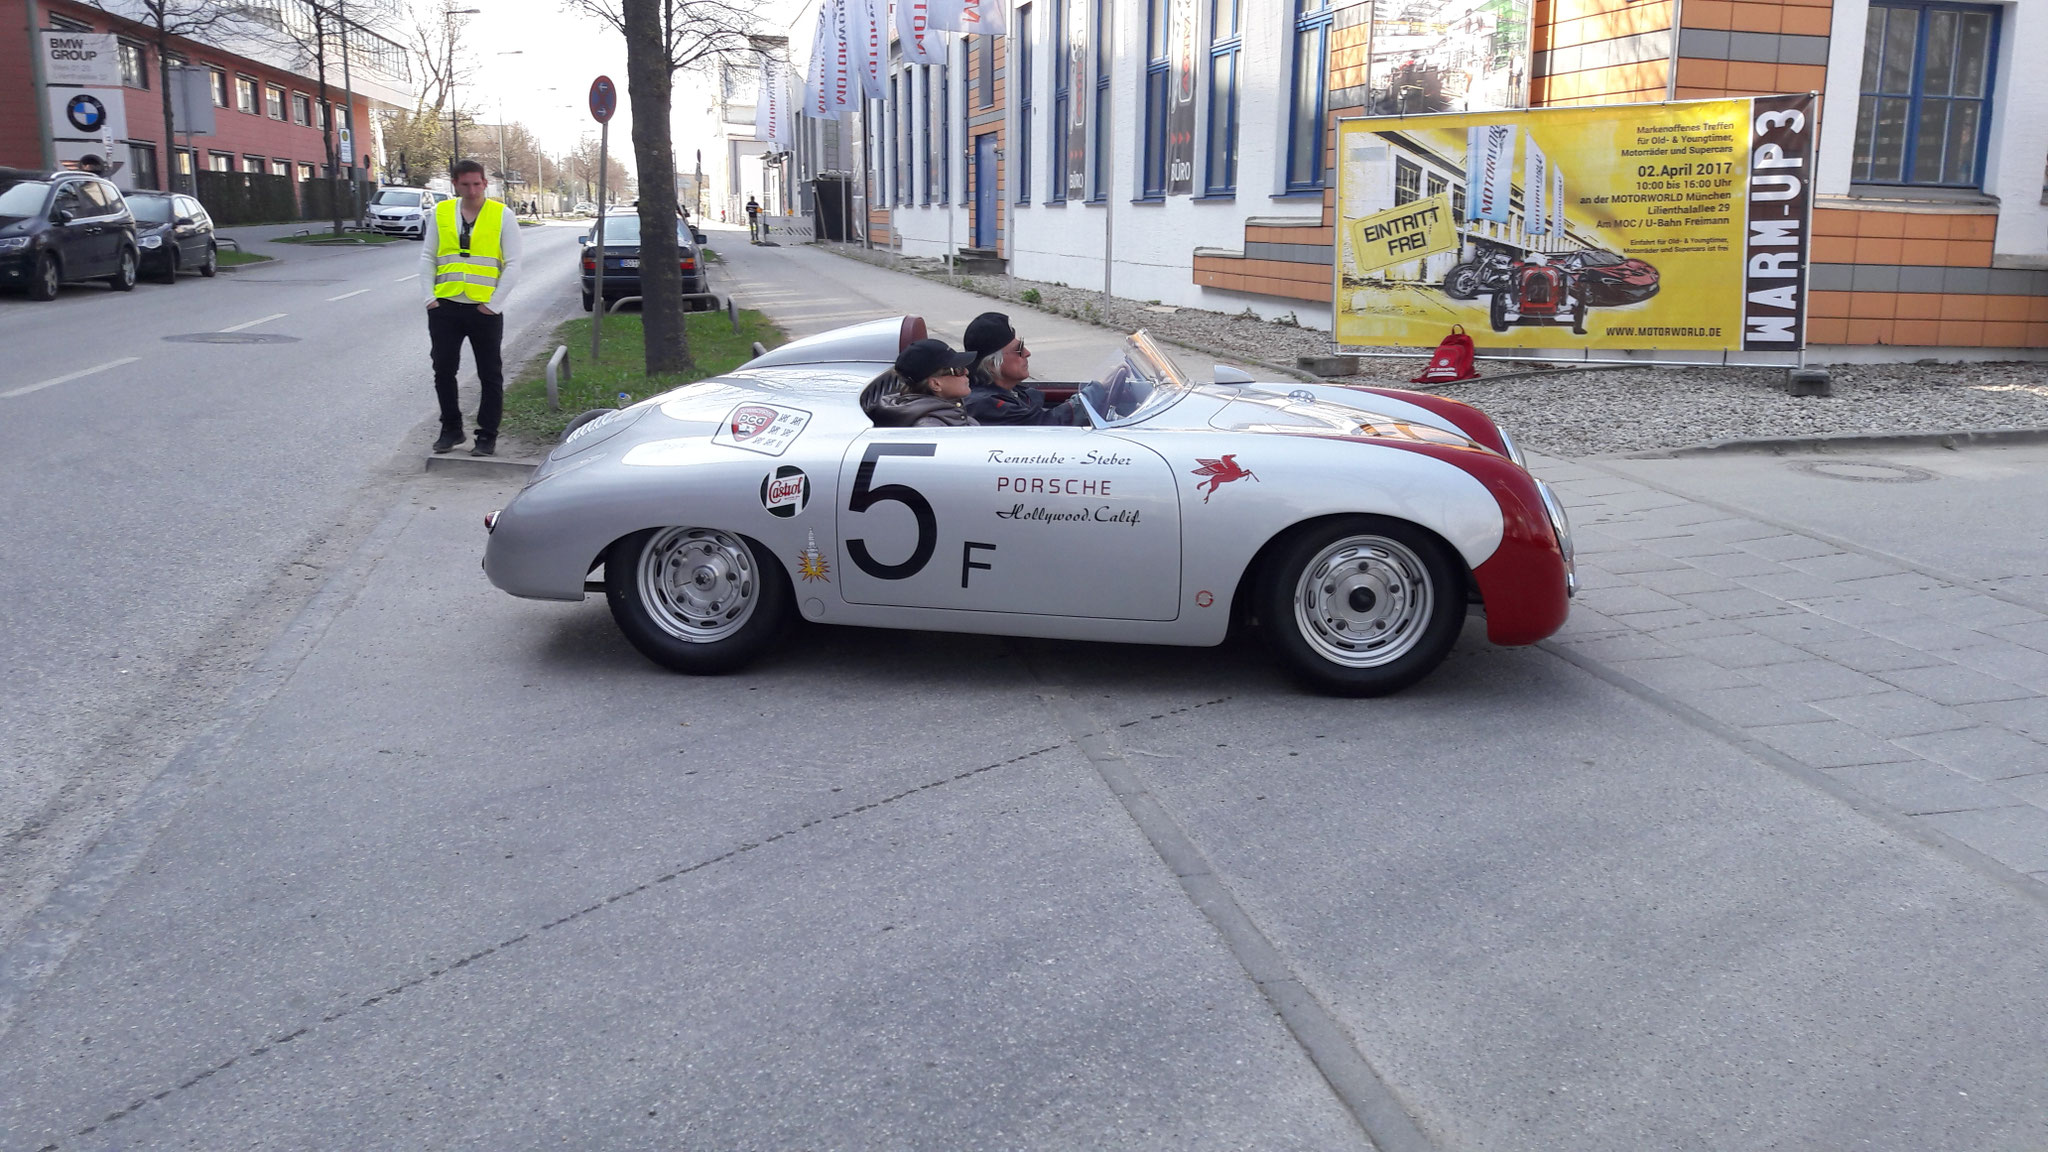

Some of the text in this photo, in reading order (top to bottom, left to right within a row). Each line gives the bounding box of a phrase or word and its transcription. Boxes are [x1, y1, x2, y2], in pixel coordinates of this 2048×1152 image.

[50, 38, 83, 49] BMW
[51, 49, 97, 61] GROUP
[1637, 122, 1734, 134] Markenoffenes Treffen
[1637, 137, 1649, 145] für
[1651, 136, 1669, 144] Old-
[1681, 134, 1733, 145] Youngtimer,
[1621, 146, 1733, 157] Motorräder und Supercars
[1171, 159, 1191, 182] BÜRO
[1638, 162, 1732, 179] 02.April 2017
[1070, 171, 1084, 189] BÜRO
[1636, 179, 1732, 190] 10:00 bis 16:00 Uhr
[1594, 195, 1609, 204] der
[1611, 193, 1683, 203] MOTORWORLD
[1686, 191, 1731, 201] München
[1648, 203, 1730, 215] Lilienthalallee 29
[1364, 206, 1440, 243] EINTRITT
[1596, 216, 1729, 228] Am MOC / U-Bahn Freimann
[1746, 109, 1805, 342] WARM-UP 3
[1387, 231, 1427, 256] FREI
[1606, 327, 1722, 337] WWW.MOTORWORLD.DE
[739, 414, 766, 426] pca
[988, 450, 1065, 464] Rennstube
[1080, 450, 1132, 465] Steber
[768, 476, 803, 504] Castrol
[998, 477, 1112, 496] PORSCHE
[846, 443, 938, 580] 5
[961, 541, 997, 588] F
